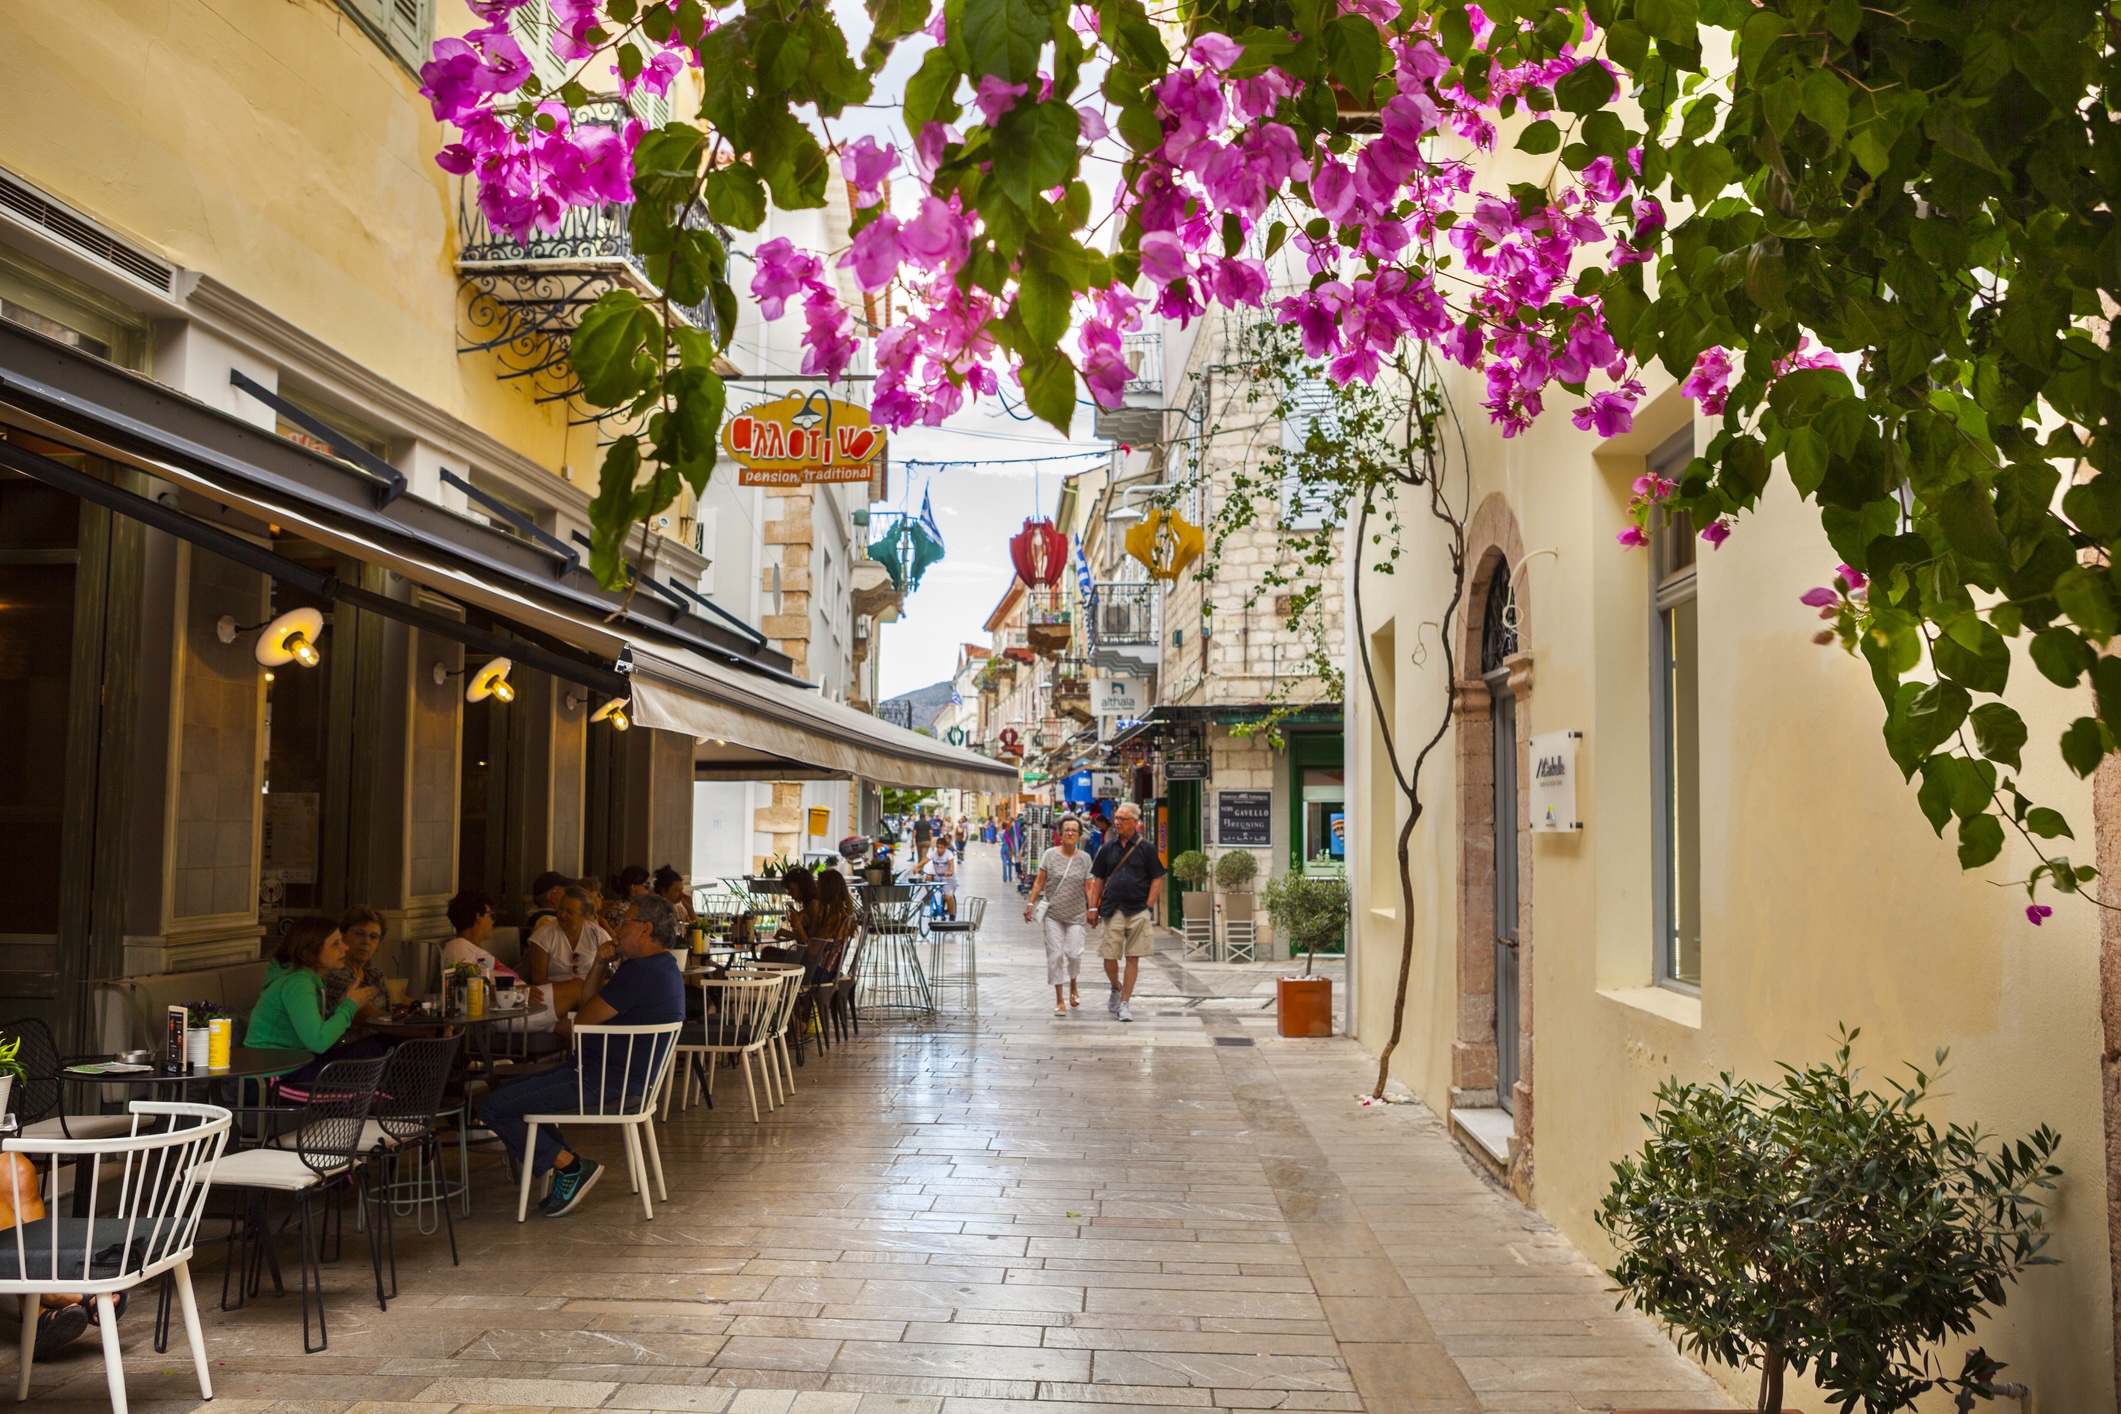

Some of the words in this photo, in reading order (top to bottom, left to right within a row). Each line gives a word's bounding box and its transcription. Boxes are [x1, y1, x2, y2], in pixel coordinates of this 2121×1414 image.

[803, 466, 871, 481] traditional
[1101, 696, 1135, 707] althaia
[1234, 809, 1269, 817] GAVELLO
